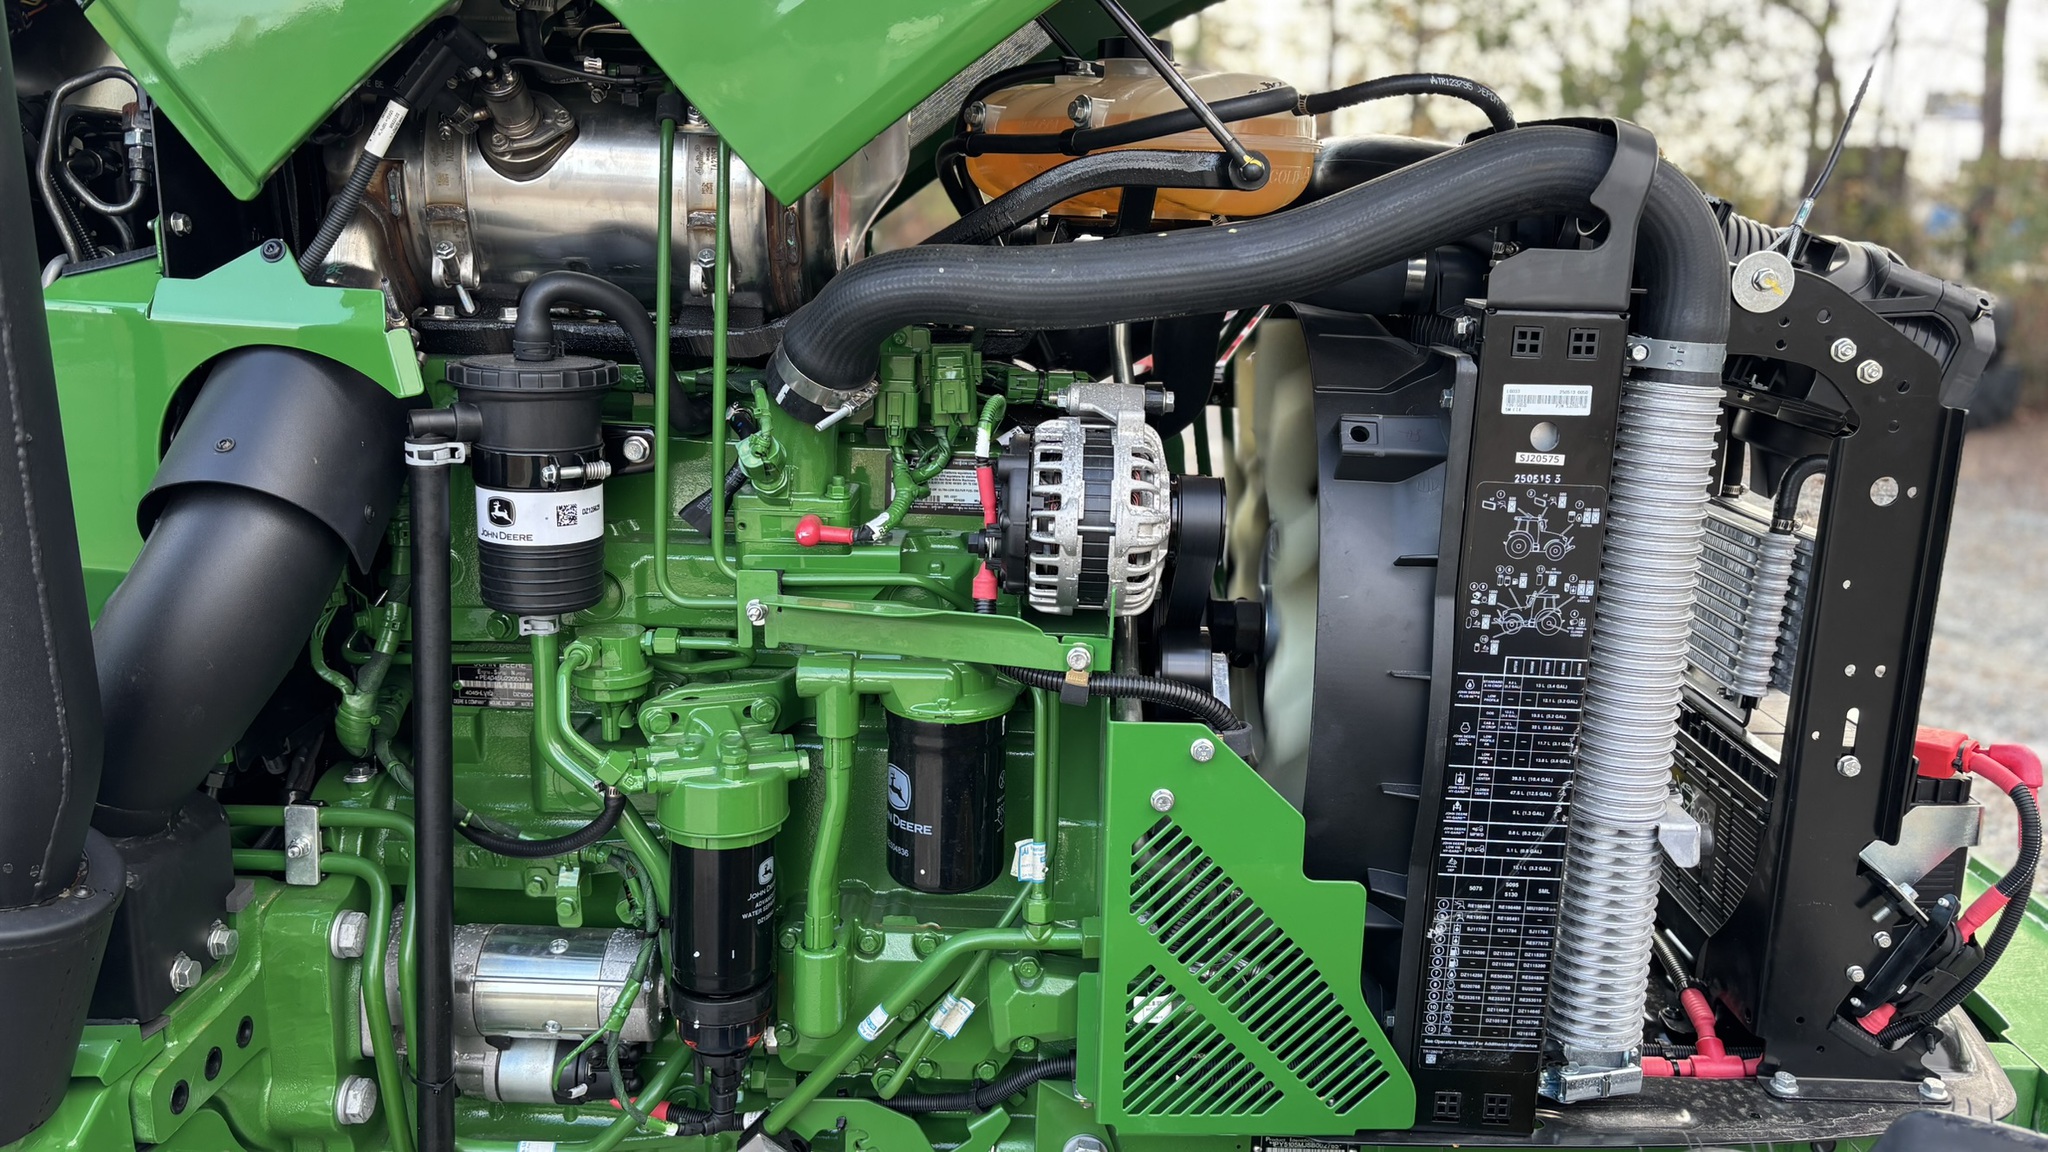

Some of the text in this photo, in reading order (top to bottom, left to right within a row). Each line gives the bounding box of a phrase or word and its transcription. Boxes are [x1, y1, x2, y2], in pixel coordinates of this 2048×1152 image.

[1520, 454, 1560, 464] SJ20575
[1514, 474, 1561, 483] 250515 3
[481, 528, 533, 541] JOHN DEERE
[893, 814, 932, 835] DEERE
[747, 890, 766, 901] JOHN
[742, 908, 762, 919] WATER
